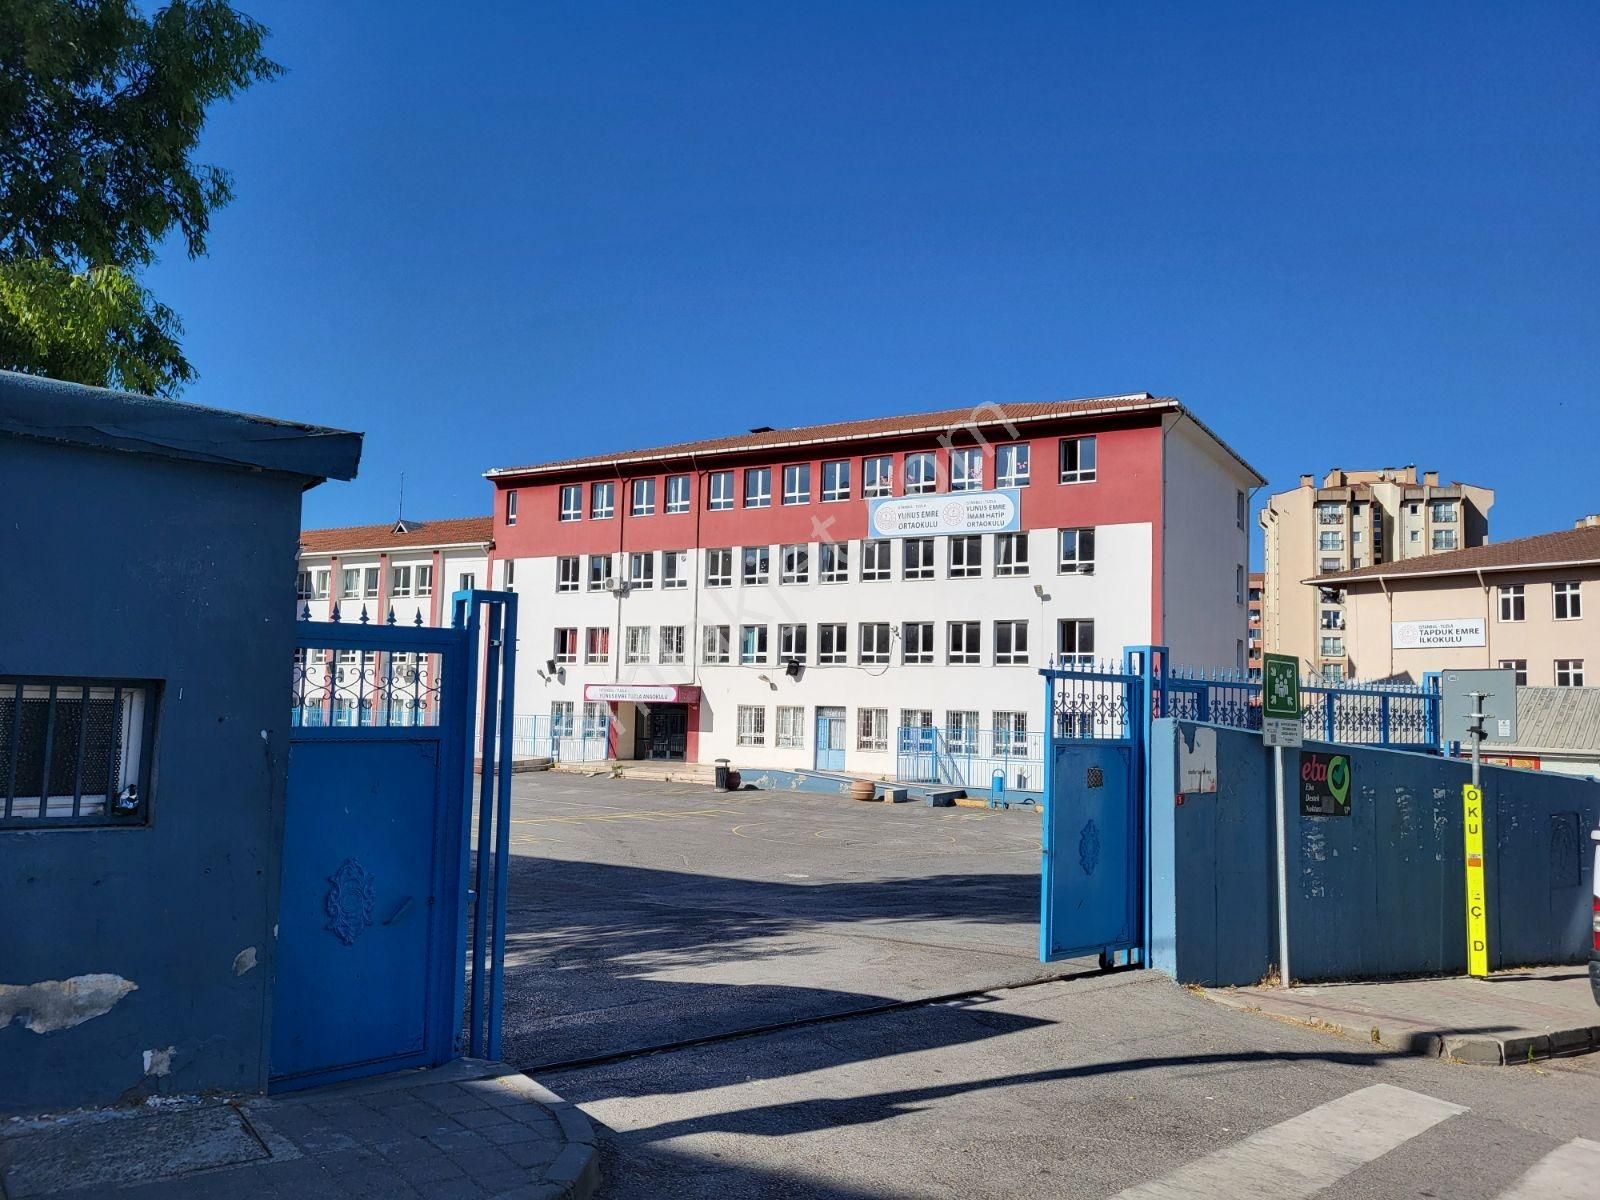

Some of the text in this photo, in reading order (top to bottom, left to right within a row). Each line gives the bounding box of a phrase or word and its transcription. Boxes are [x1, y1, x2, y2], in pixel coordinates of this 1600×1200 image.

[921, 510, 939, 518] EMRE
[898, 521, 938, 529] ORTAOKULU
[1302, 754, 1328, 782] eba
[1467, 790, 1479, 849] OKU
